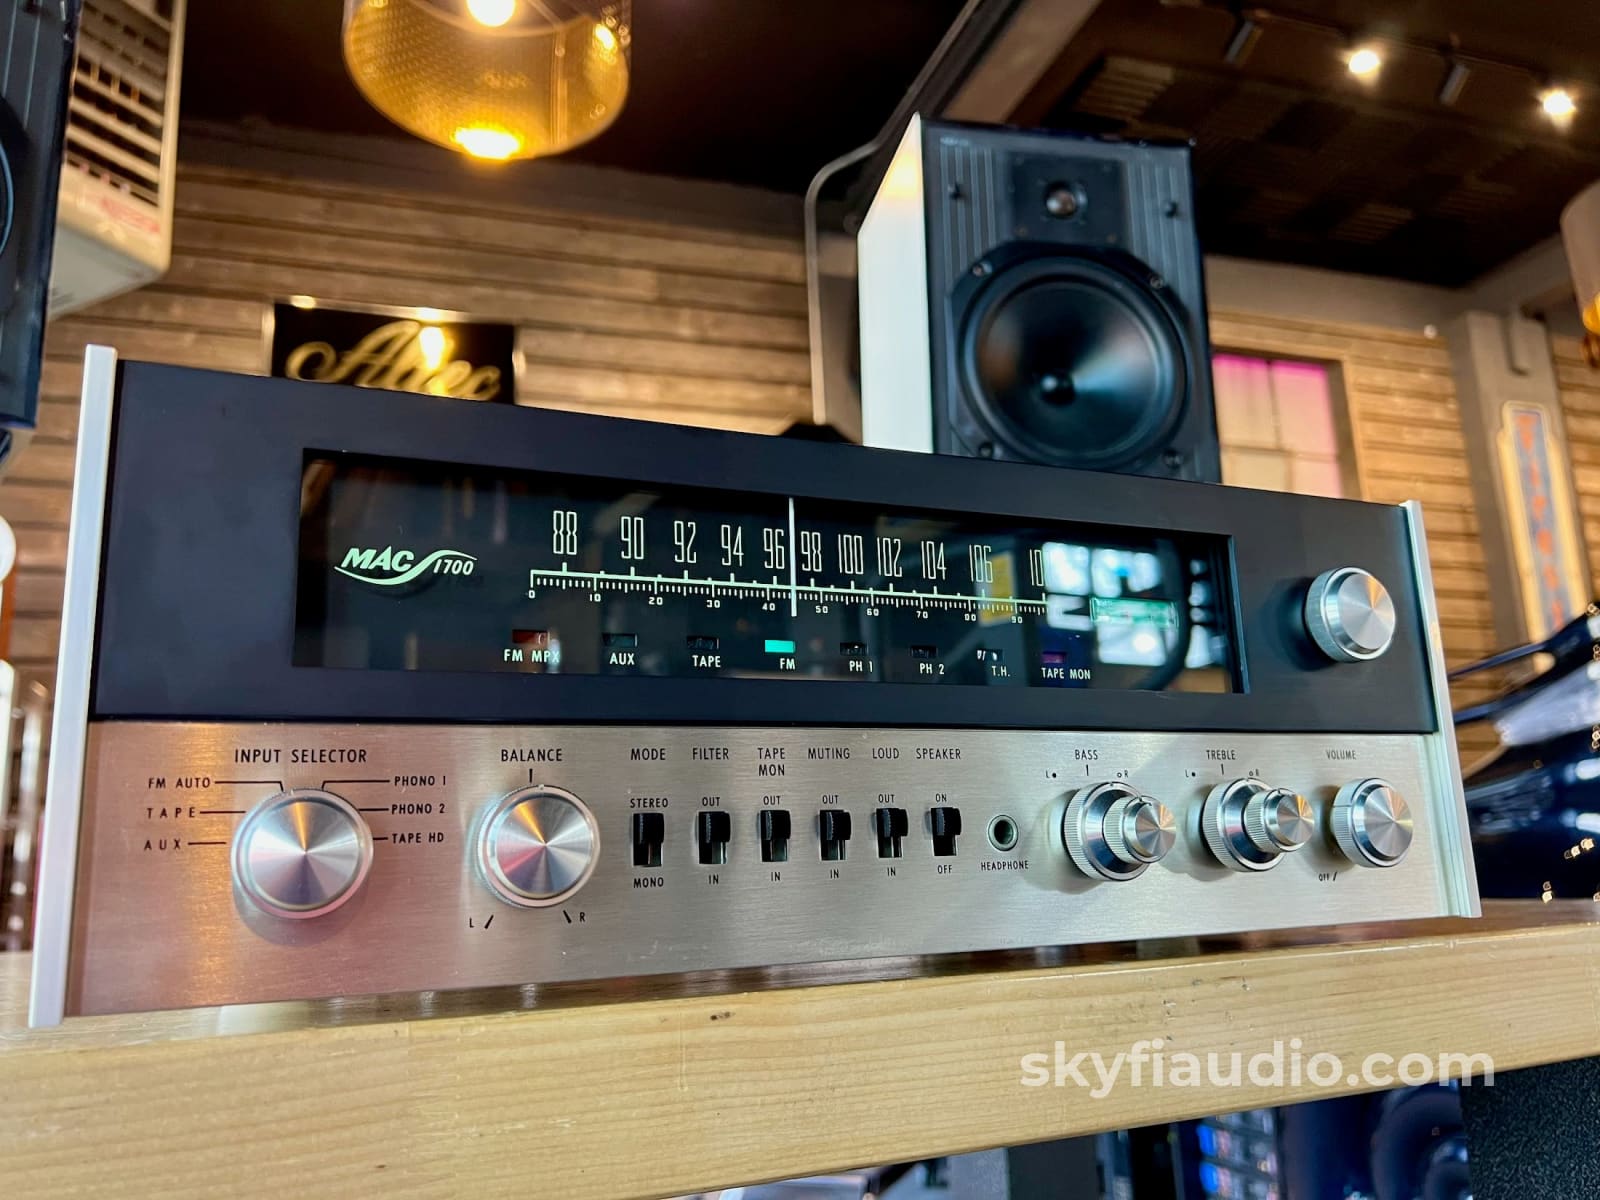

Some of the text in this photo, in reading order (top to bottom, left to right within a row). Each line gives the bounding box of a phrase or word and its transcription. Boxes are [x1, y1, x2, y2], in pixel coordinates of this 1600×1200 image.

[553, 510, 1045, 587] 88 90 92 94 96 98 100 102 104 106 10
[341, 546, 475, 576] MAC 1700
[528, 590, 536, 599] 0
[589, 593, 601, 602] 10
[648, 597, 663, 606] 20
[706, 599, 721, 609] 30
[762, 602, 776, 612] 40
[815, 605, 829, 614] 50
[866, 608, 879, 617] 60
[916, 611, 929, 620] 70
[503, 649, 560, 664] FM MPX
[609, 652, 635, 666] AUX
[692, 655, 721, 668] TAPE
[779, 657, 796, 671] FM
[849, 660, 873, 673] PH 1
[919, 663, 945, 675] PH 2
[991, 665, 1011, 677] T.H.
[1041, 667, 1091, 680] TAPE MON
[235, 748, 367, 763] INPUT SELECTOR
[501, 748, 563, 762] BALANCE
[630, 748, 666, 761] MODE
[692, 747, 730, 760] FILTER
[757, 747, 785, 760] TAPE
[807, 747, 850, 760] MUTING
[872, 747, 899, 759] LOUD
[916, 748, 961, 760] SPEAKER
[1074, 749, 1099, 760] BASS
[1206, 749, 1236, 761] TREBLE
[1326, 749, 1357, 761] VOLUME
[758, 764, 785, 776] MON
[148, 777, 211, 789] FM AUTO
[394, 775, 447, 787] PHONO 1
[630, 797, 669, 809] STEREO
[701, 796, 721, 807] OUT
[763, 795, 781, 806] OUT
[822, 794, 839, 805] OUT
[878, 793, 895, 804] OUT
[935, 793, 947, 803] ON
[147, 807, 196, 819] TAPE
[392, 803, 446, 815] PHONO 2
[392, 831, 444, 844] TAPE HD
[144, 838, 181, 851] AUX
[887, 866, 896, 877] IN
[937, 865, 953, 875] OFF
[980, 859, 1029, 872] HEADPHONE
[708, 874, 719, 885] IN
[770, 871, 781, 882] IN
[830, 869, 839, 880] IN
[633, 877, 664, 889] MONO
[469, 917, 474, 928] L
[579, 912, 586, 923] R
